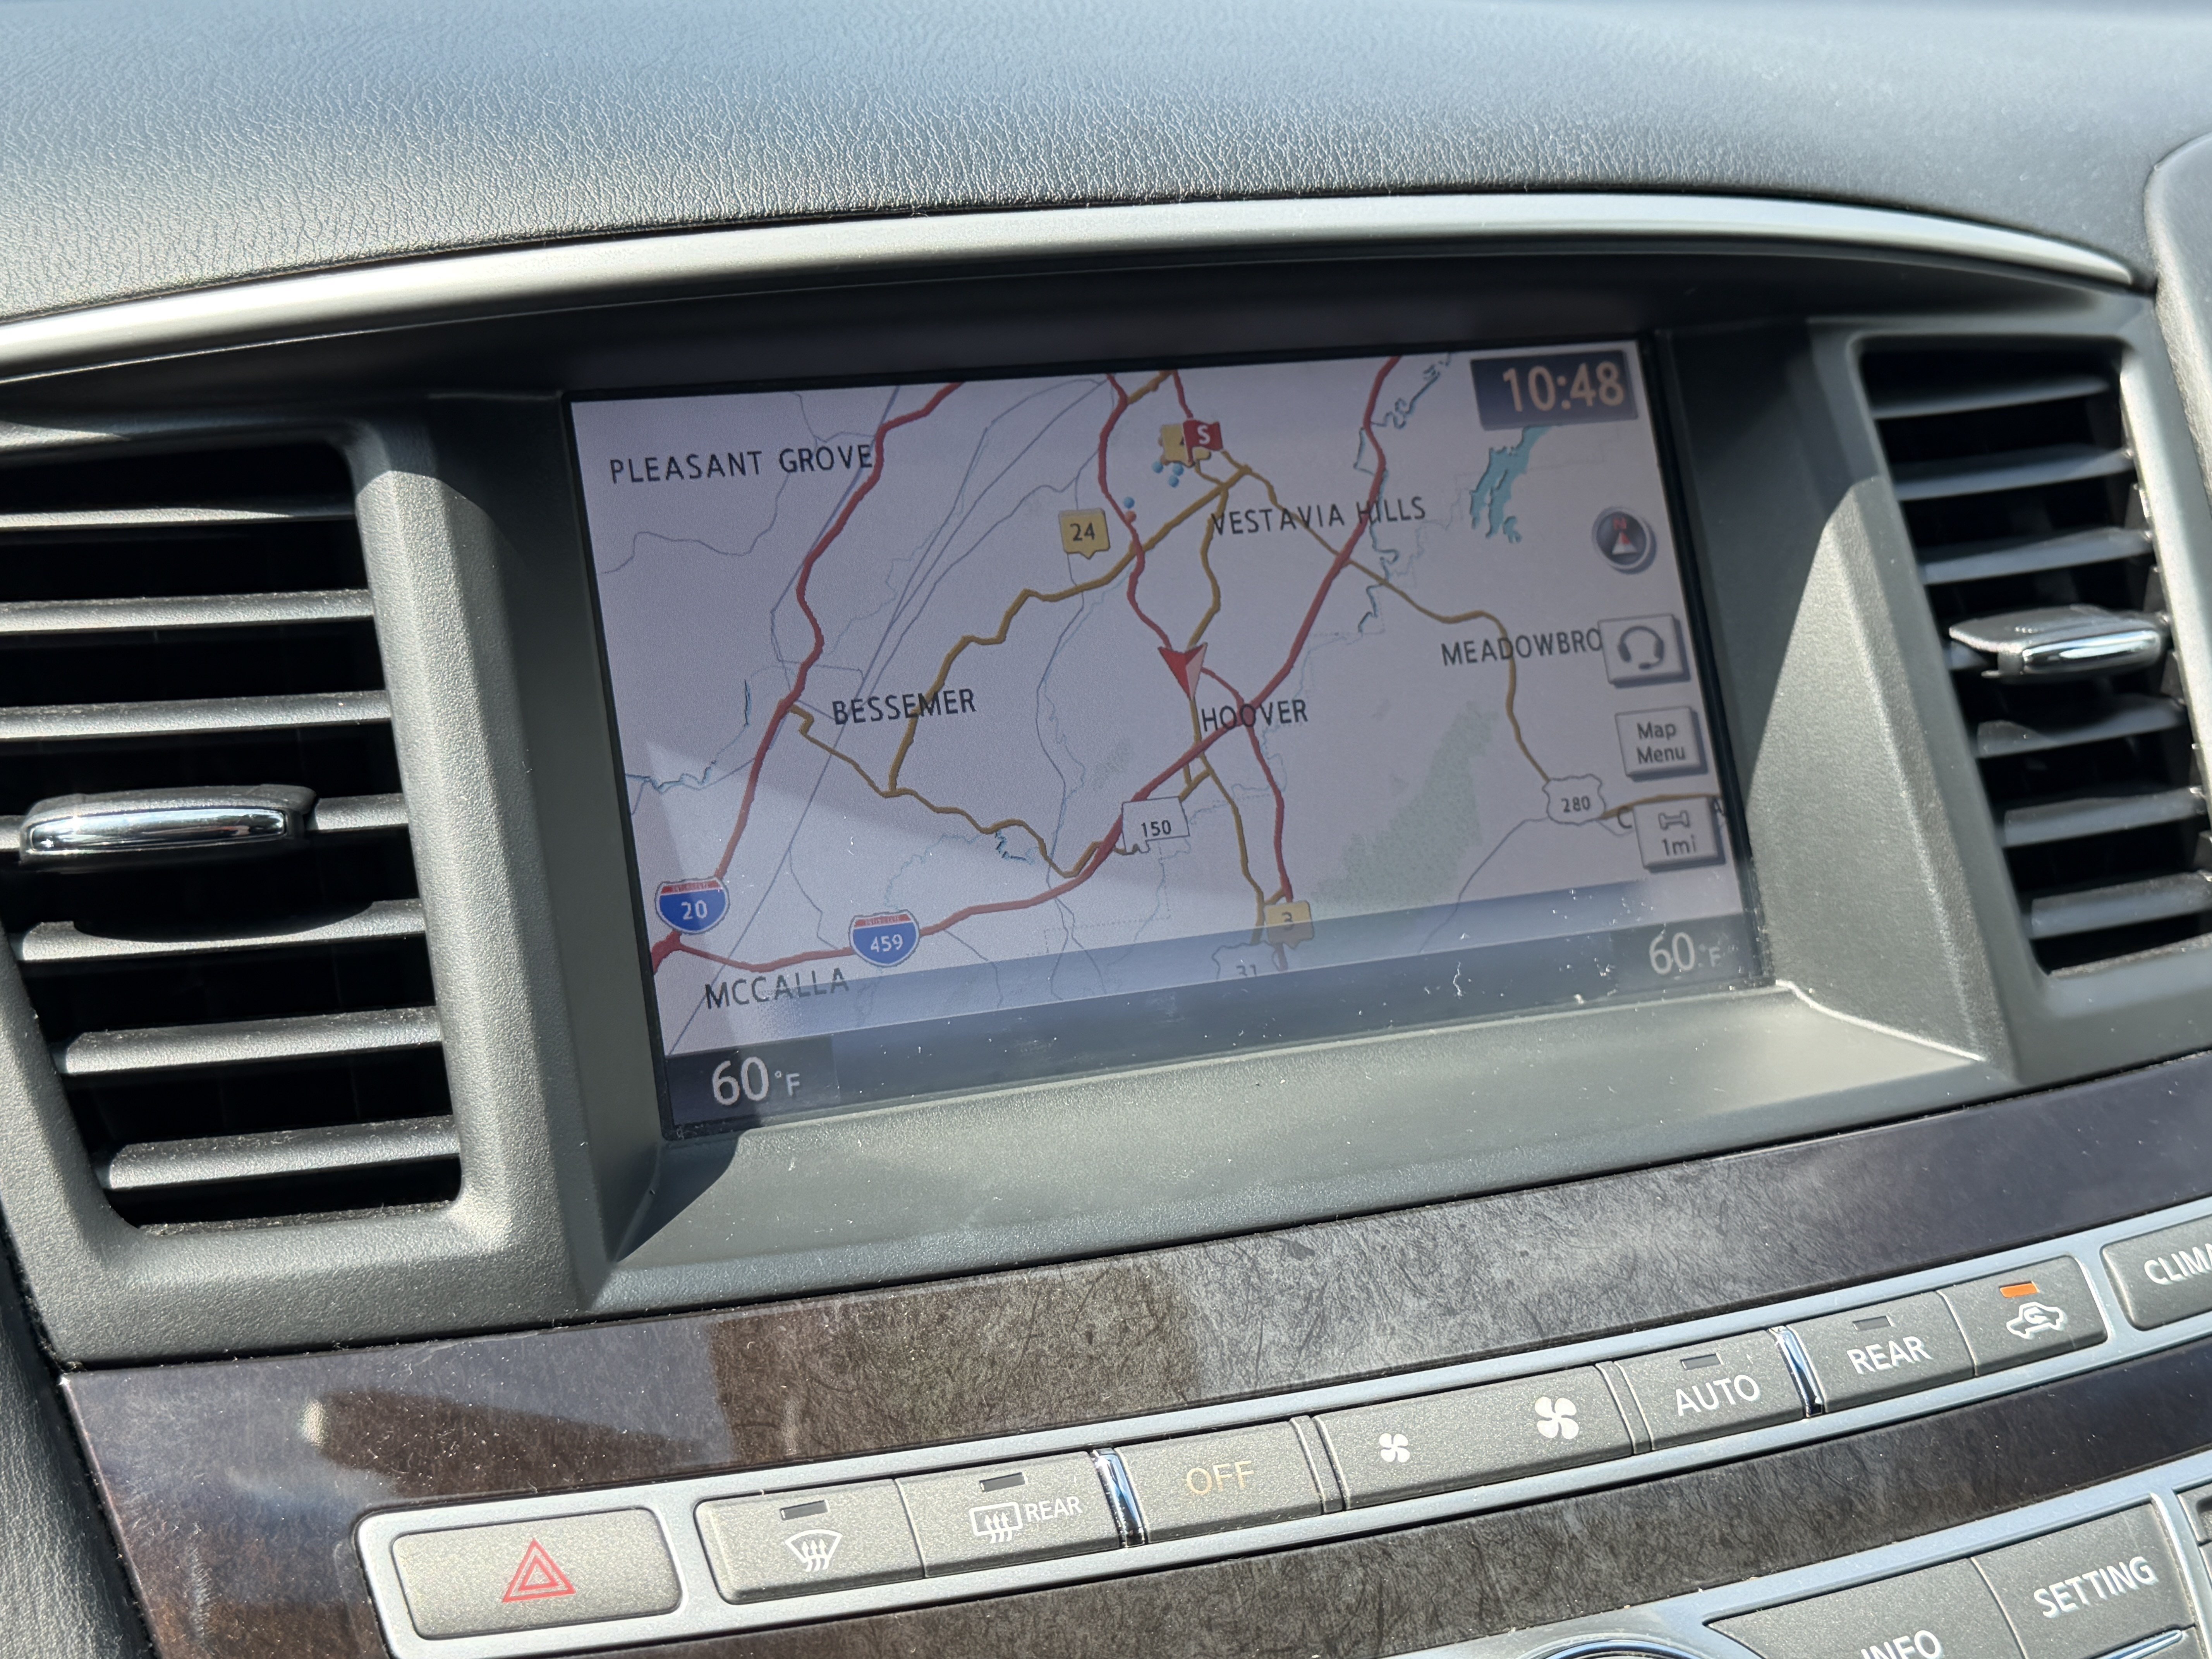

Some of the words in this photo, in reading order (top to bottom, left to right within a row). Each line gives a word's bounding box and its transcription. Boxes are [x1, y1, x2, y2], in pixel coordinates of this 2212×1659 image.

[1503, 361, 1623, 412] 10:48
[610, 450, 762, 484] PLEASANT
[778, 444, 874, 474] GROVE
[1070, 522, 1096, 542] 24
[1211, 503, 1345, 536] VESTAVIA
[1356, 496, 1427, 524] HILLS
[1441, 627, 1603, 666] MEADOWBRO
[832, 688, 977, 725] BESSEMER
[1201, 699, 1309, 732] HOOVER
[1637, 721, 1676, 742] Map
[1637, 745, 1686, 765] Menu
[1561, 795, 1591, 813] 280
[1141, 819, 1172, 838] 150
[681, 900, 708, 920] 20
[1282, 911, 1294, 931] 3
[870, 934, 903, 953] 459
[705, 967, 850, 1009] MCCALLA
[1846, 1336, 1934, 1375] REAR
[1674, 1374, 1760, 1416] AUTO
[1186, 1460, 1255, 1496] OFF
[1025, 1496, 1083, 1523] REAR
[2033, 1556, 2159, 1618] SETTING
